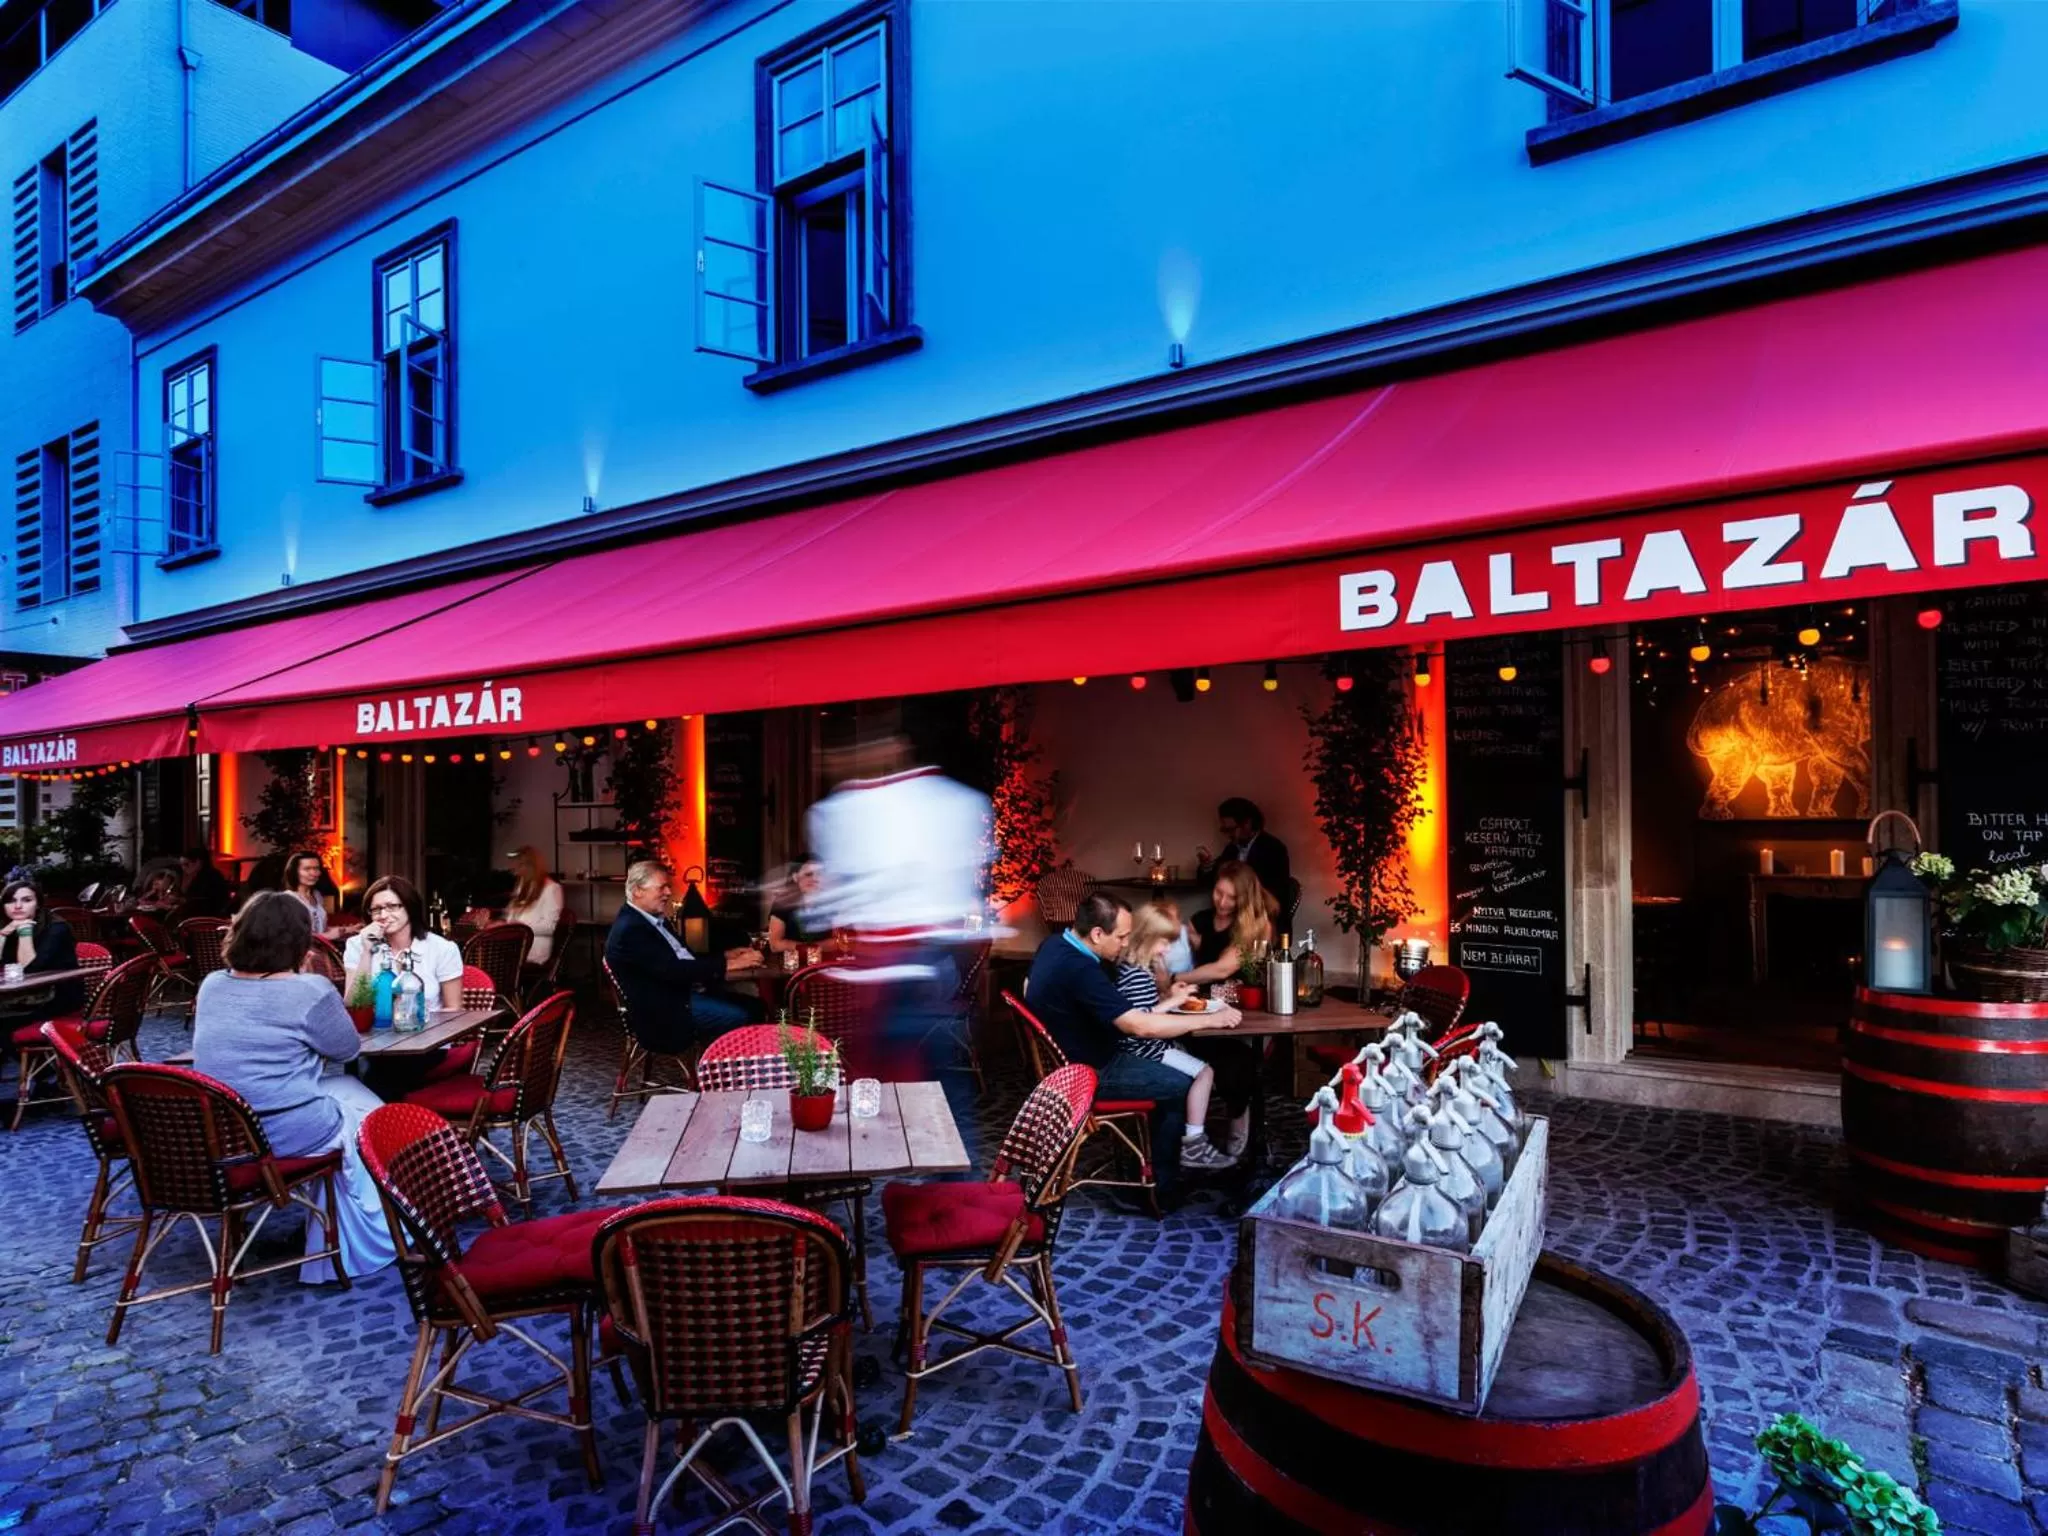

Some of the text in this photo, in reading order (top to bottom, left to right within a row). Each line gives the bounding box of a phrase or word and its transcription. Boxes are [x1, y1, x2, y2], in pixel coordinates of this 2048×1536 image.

[1338, 480, 2035, 632] BALTAZÁR
[356, 680, 523, 735] BALTAZÁR
[2, 733, 77, 768] BALTAZÁR
[1965, 811, 2027, 826] BITTER
[1982, 829, 2044, 842] ON TAP
[1988, 844, 2032, 864] local
[1450, 919, 1462, 933] ÉS
[1465, 923, 1499, 935] MINDEN
[1463, 950, 1539, 967] NEM BEJÁRAT
